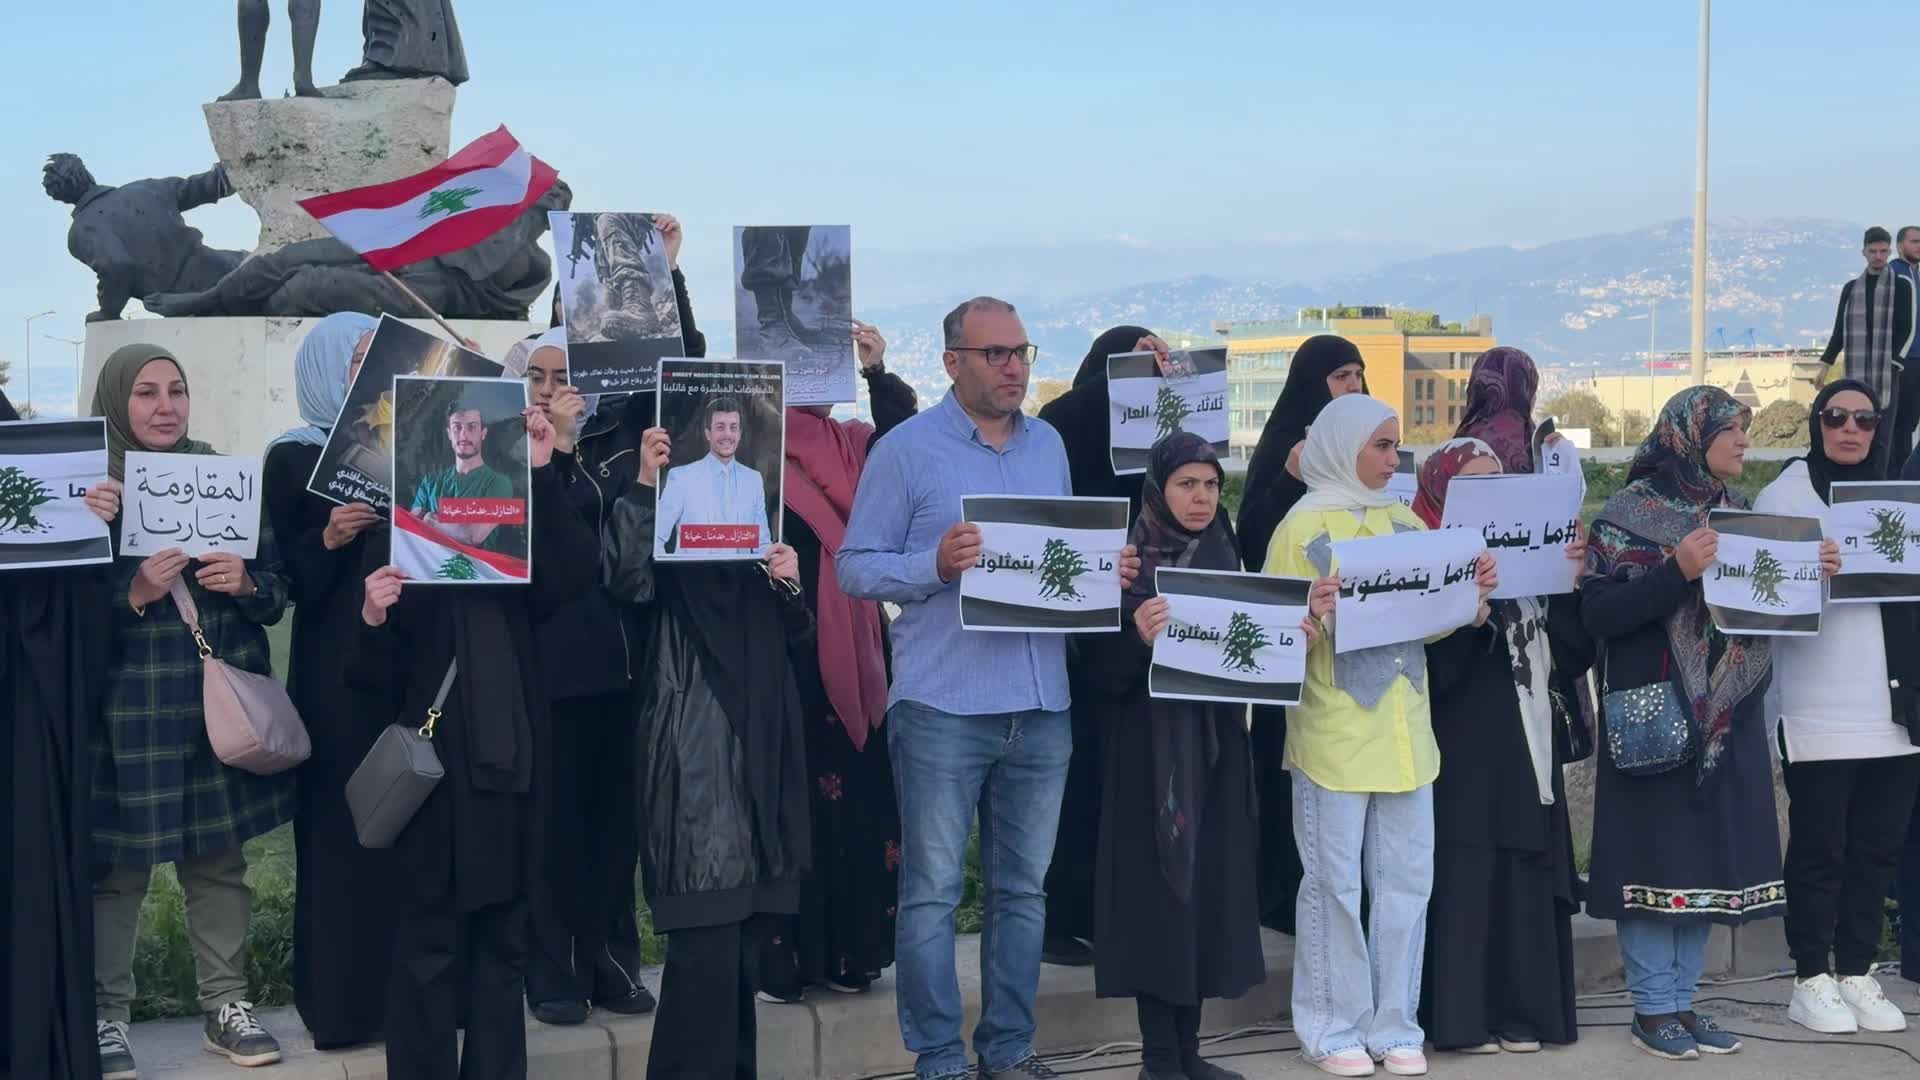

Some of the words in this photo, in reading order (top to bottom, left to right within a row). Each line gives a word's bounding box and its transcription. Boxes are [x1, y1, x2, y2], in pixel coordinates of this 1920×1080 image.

[1196, 394, 1225, 413] ثلاثاء
[1120, 404, 1149, 424] العار
[69, 483, 87, 498] ما
[975, 552, 1034, 574] بتمثلون
[1098, 556, 1113, 571] ما
[1714, 563, 1746, 581] العار
[1167, 623, 1220, 645] بتمثلونا
[1279, 632, 1295, 646] ما
